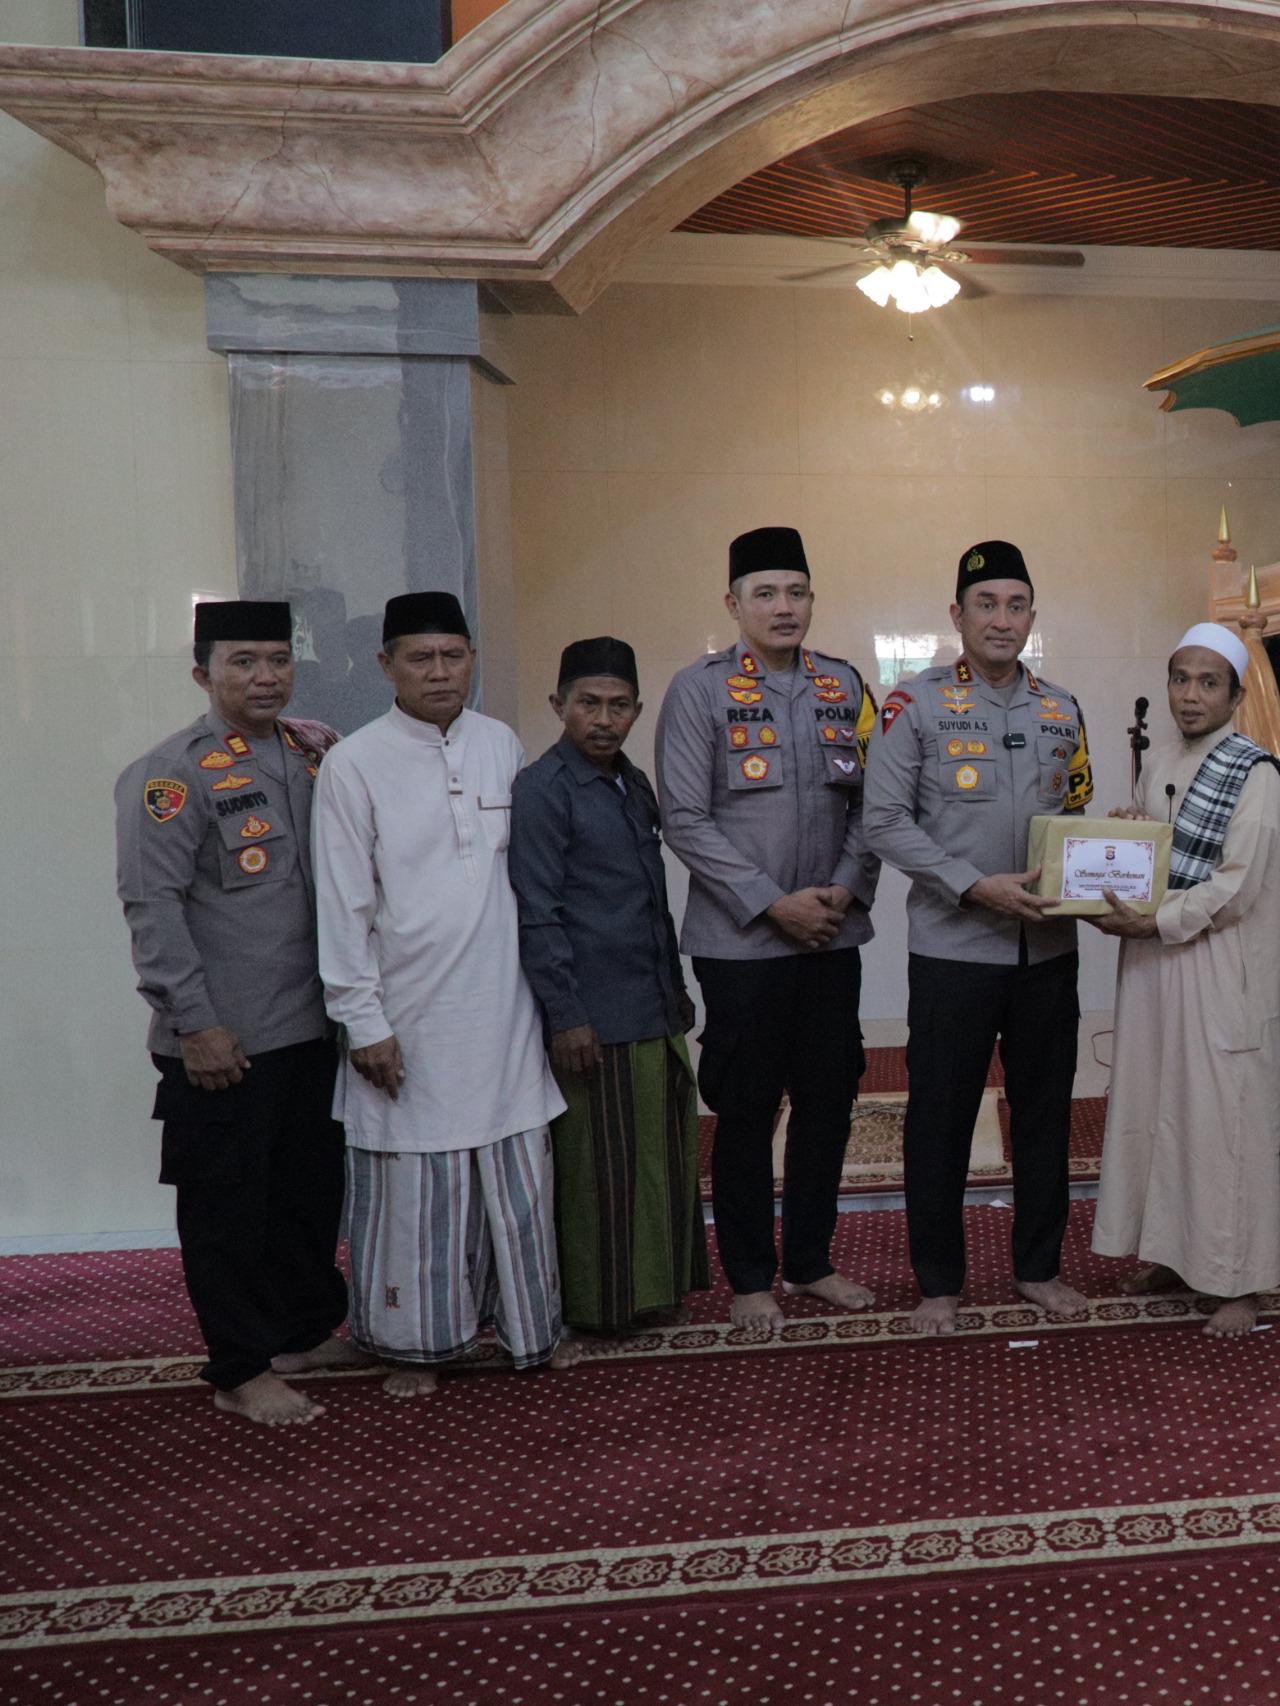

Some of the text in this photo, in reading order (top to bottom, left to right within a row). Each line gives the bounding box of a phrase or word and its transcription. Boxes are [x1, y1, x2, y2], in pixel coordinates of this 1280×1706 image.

[726, 707, 775, 723] REZA
[814, 708, 856, 723] POLRI
[938, 720, 988, 732] SUYUDI A.S
[1040, 724, 1076, 740] POLRI
